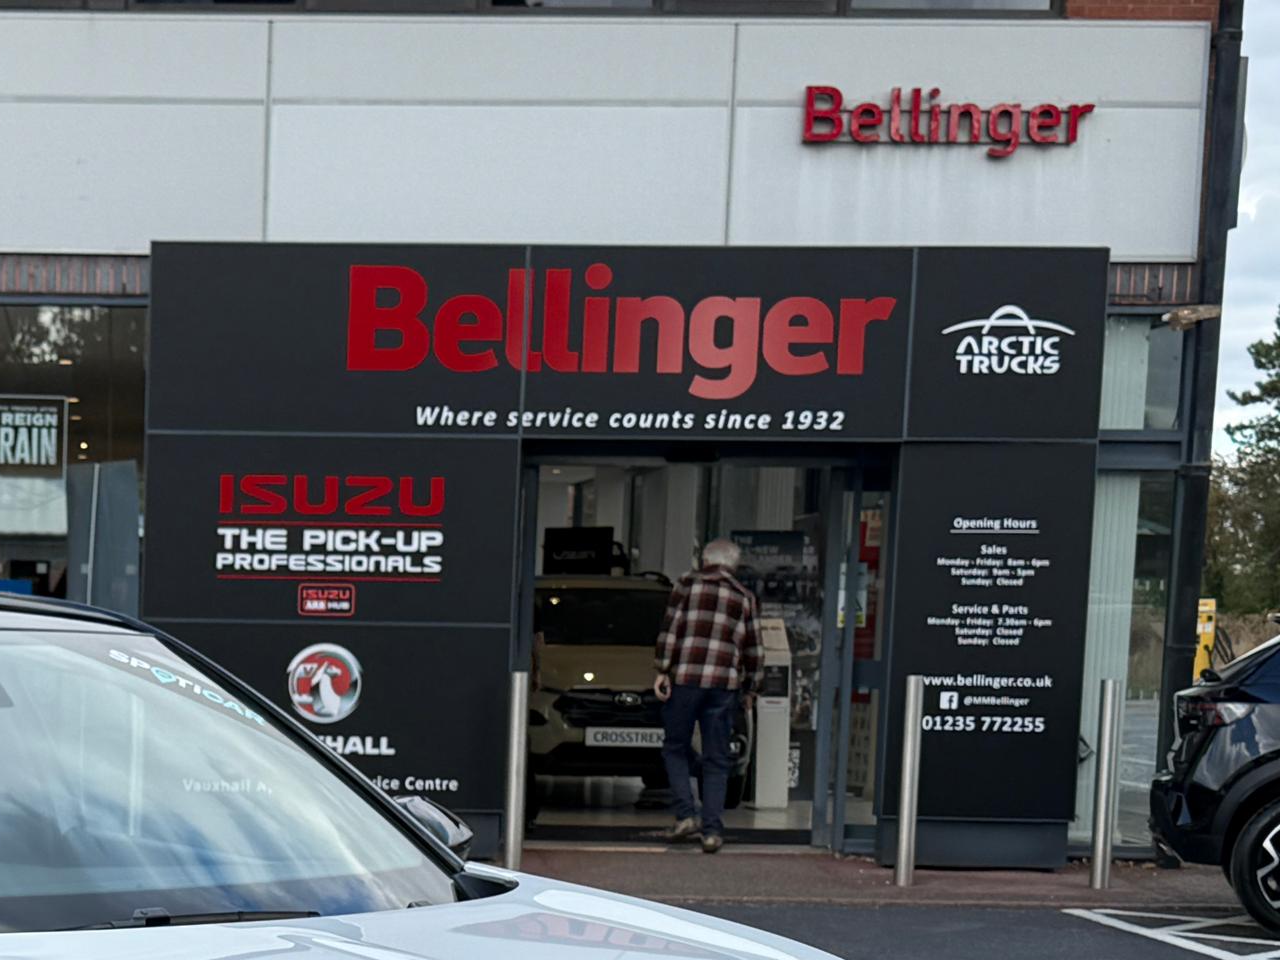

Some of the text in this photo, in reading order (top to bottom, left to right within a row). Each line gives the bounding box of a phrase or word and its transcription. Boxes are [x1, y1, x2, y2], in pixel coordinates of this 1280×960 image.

[802, 85, 1096, 158] Bellinger
[346, 262, 897, 400] Bellinger
[955, 335, 1061, 355] ARCTIC
[955, 355, 1061, 374] TRUCKS
[1, 412, 58, 427] REIGN
[415, 405, 845, 431] Where service counts since 1932
[218, 474, 446, 517] ISUZU
[953, 516, 1038, 531] Opening Hours
[216, 527, 444, 553] THE PICK-UP
[980, 544, 1008, 555] Sales
[215, 552, 443, 573] PROFESSIONALS
[937, 557, 970, 567] Monday
[996, 577, 1024, 587] Closed
[303, 589, 351, 600] ISUZU
[951, 603, 1029, 615] Service & Parts
[927, 616, 961, 626] Monday
[996, 627, 1024, 637] Closed
[992, 637, 1020, 647] Closed
[963, 695, 1031, 708] @MMBellinger
[921, 715, 1046, 733] 01235 772255
[318, 735, 397, 756] HALL
[405, 775, 459, 792] Centre
